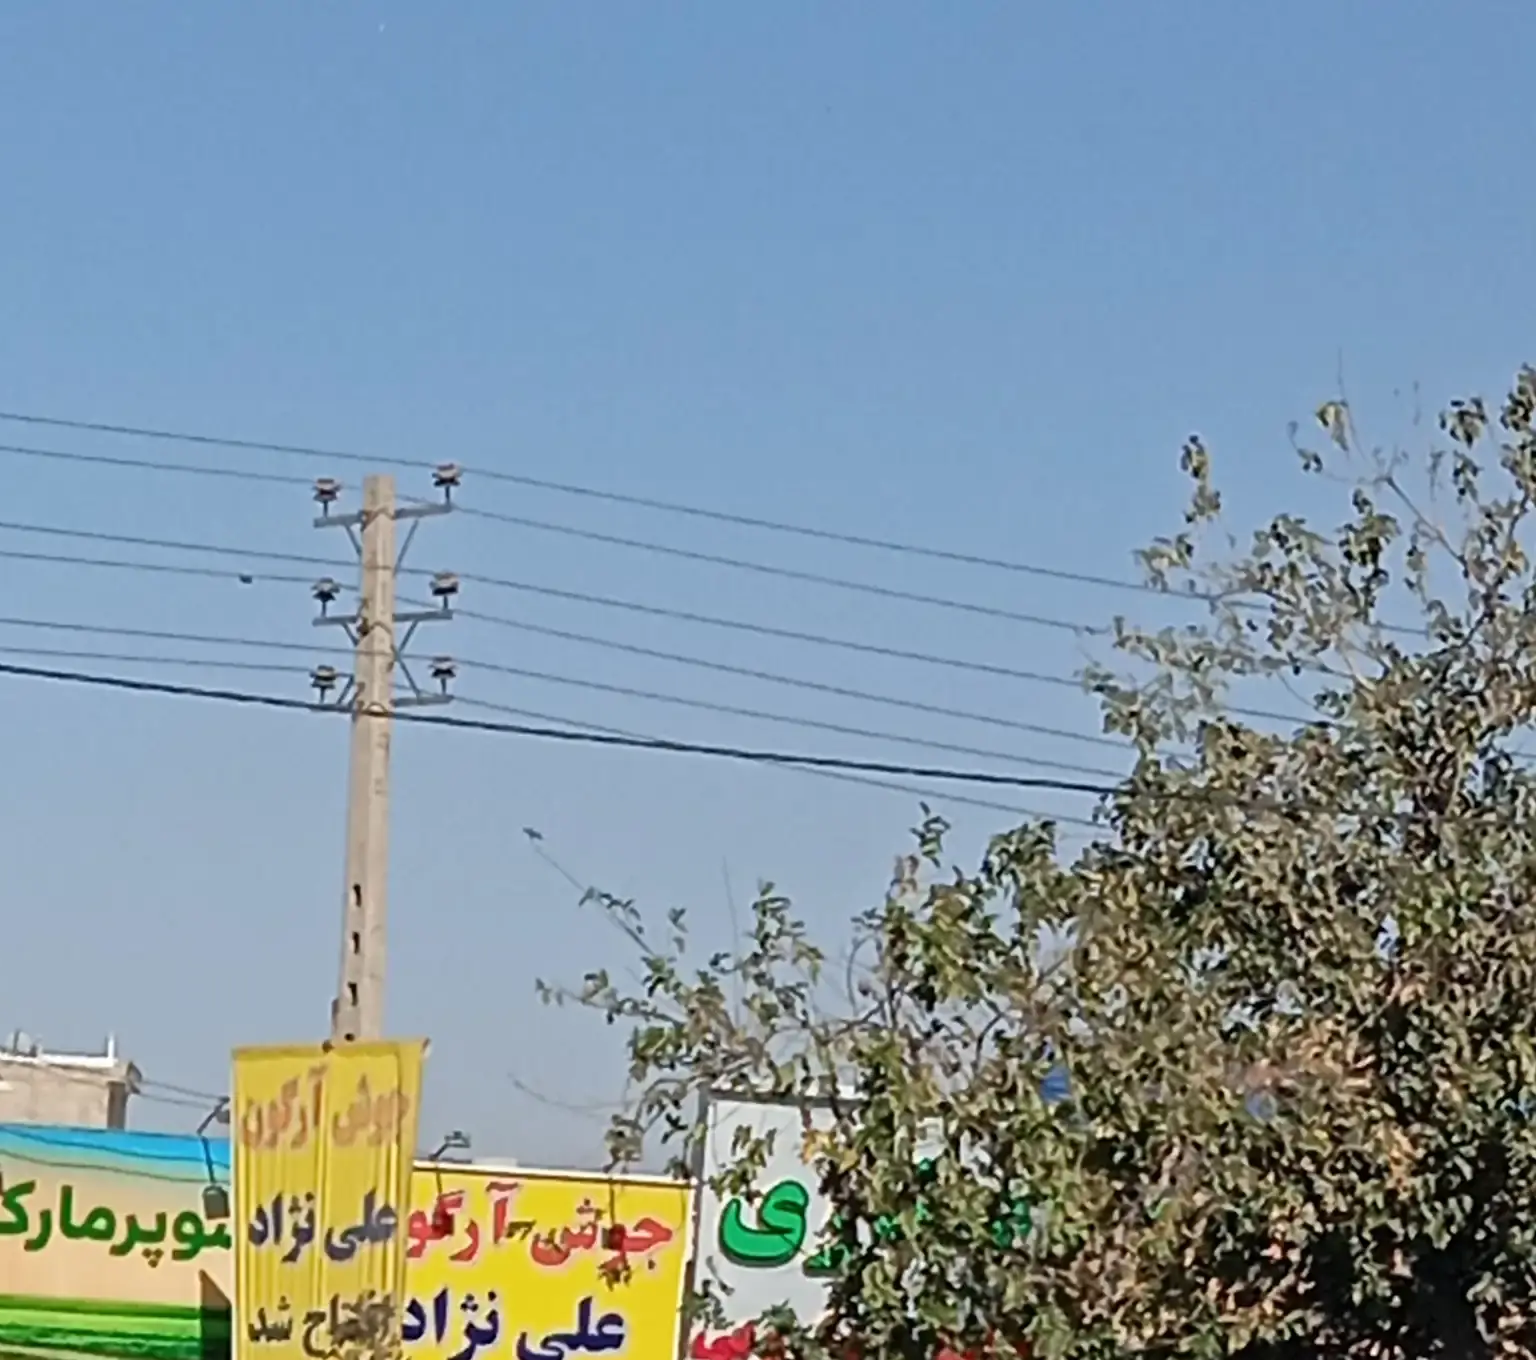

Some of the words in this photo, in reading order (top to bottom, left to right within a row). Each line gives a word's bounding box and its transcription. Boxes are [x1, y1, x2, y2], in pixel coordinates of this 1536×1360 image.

[248, 1193, 315, 1263] نژاد
[324, 1187, 401, 1261] علی
[406, 1182, 518, 1262] آرگو
[530, 1198, 673, 1271] جوش
